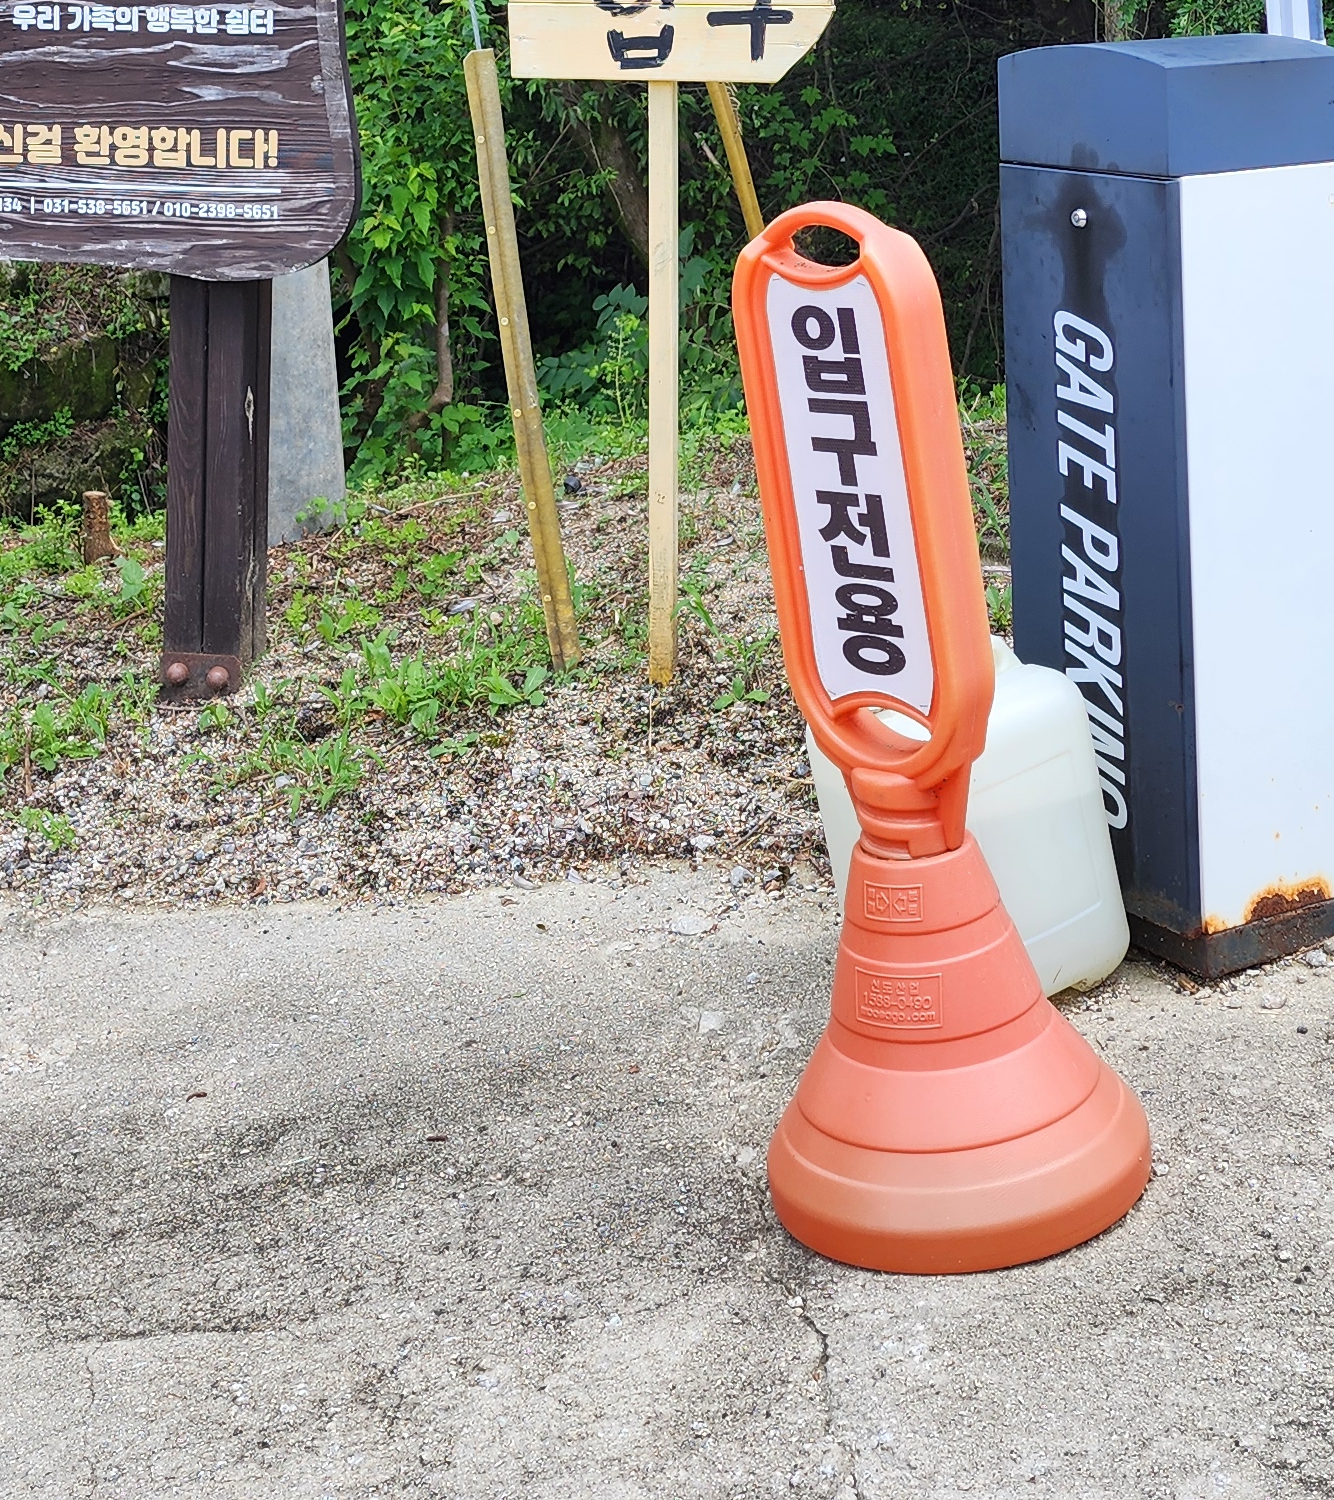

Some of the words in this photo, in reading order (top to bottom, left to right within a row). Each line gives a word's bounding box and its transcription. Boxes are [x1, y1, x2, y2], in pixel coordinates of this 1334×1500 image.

[12, 4, 61, 31] 우리
[67, 5, 139, 32] 가족의
[146, 7, 219, 34] 행복한
[225, 8, 274, 35] 쉼터
[73, 124, 279, 168] 환영합니다!
[44, 199, 148, 215] 031-538-5651
[163, 202, 279, 219] 010-2398-5651
[1053, 309, 1117, 504] GATE
[790, 304, 907, 676] 입구전용
[863, 991, 932, 1010] 1588-0490
